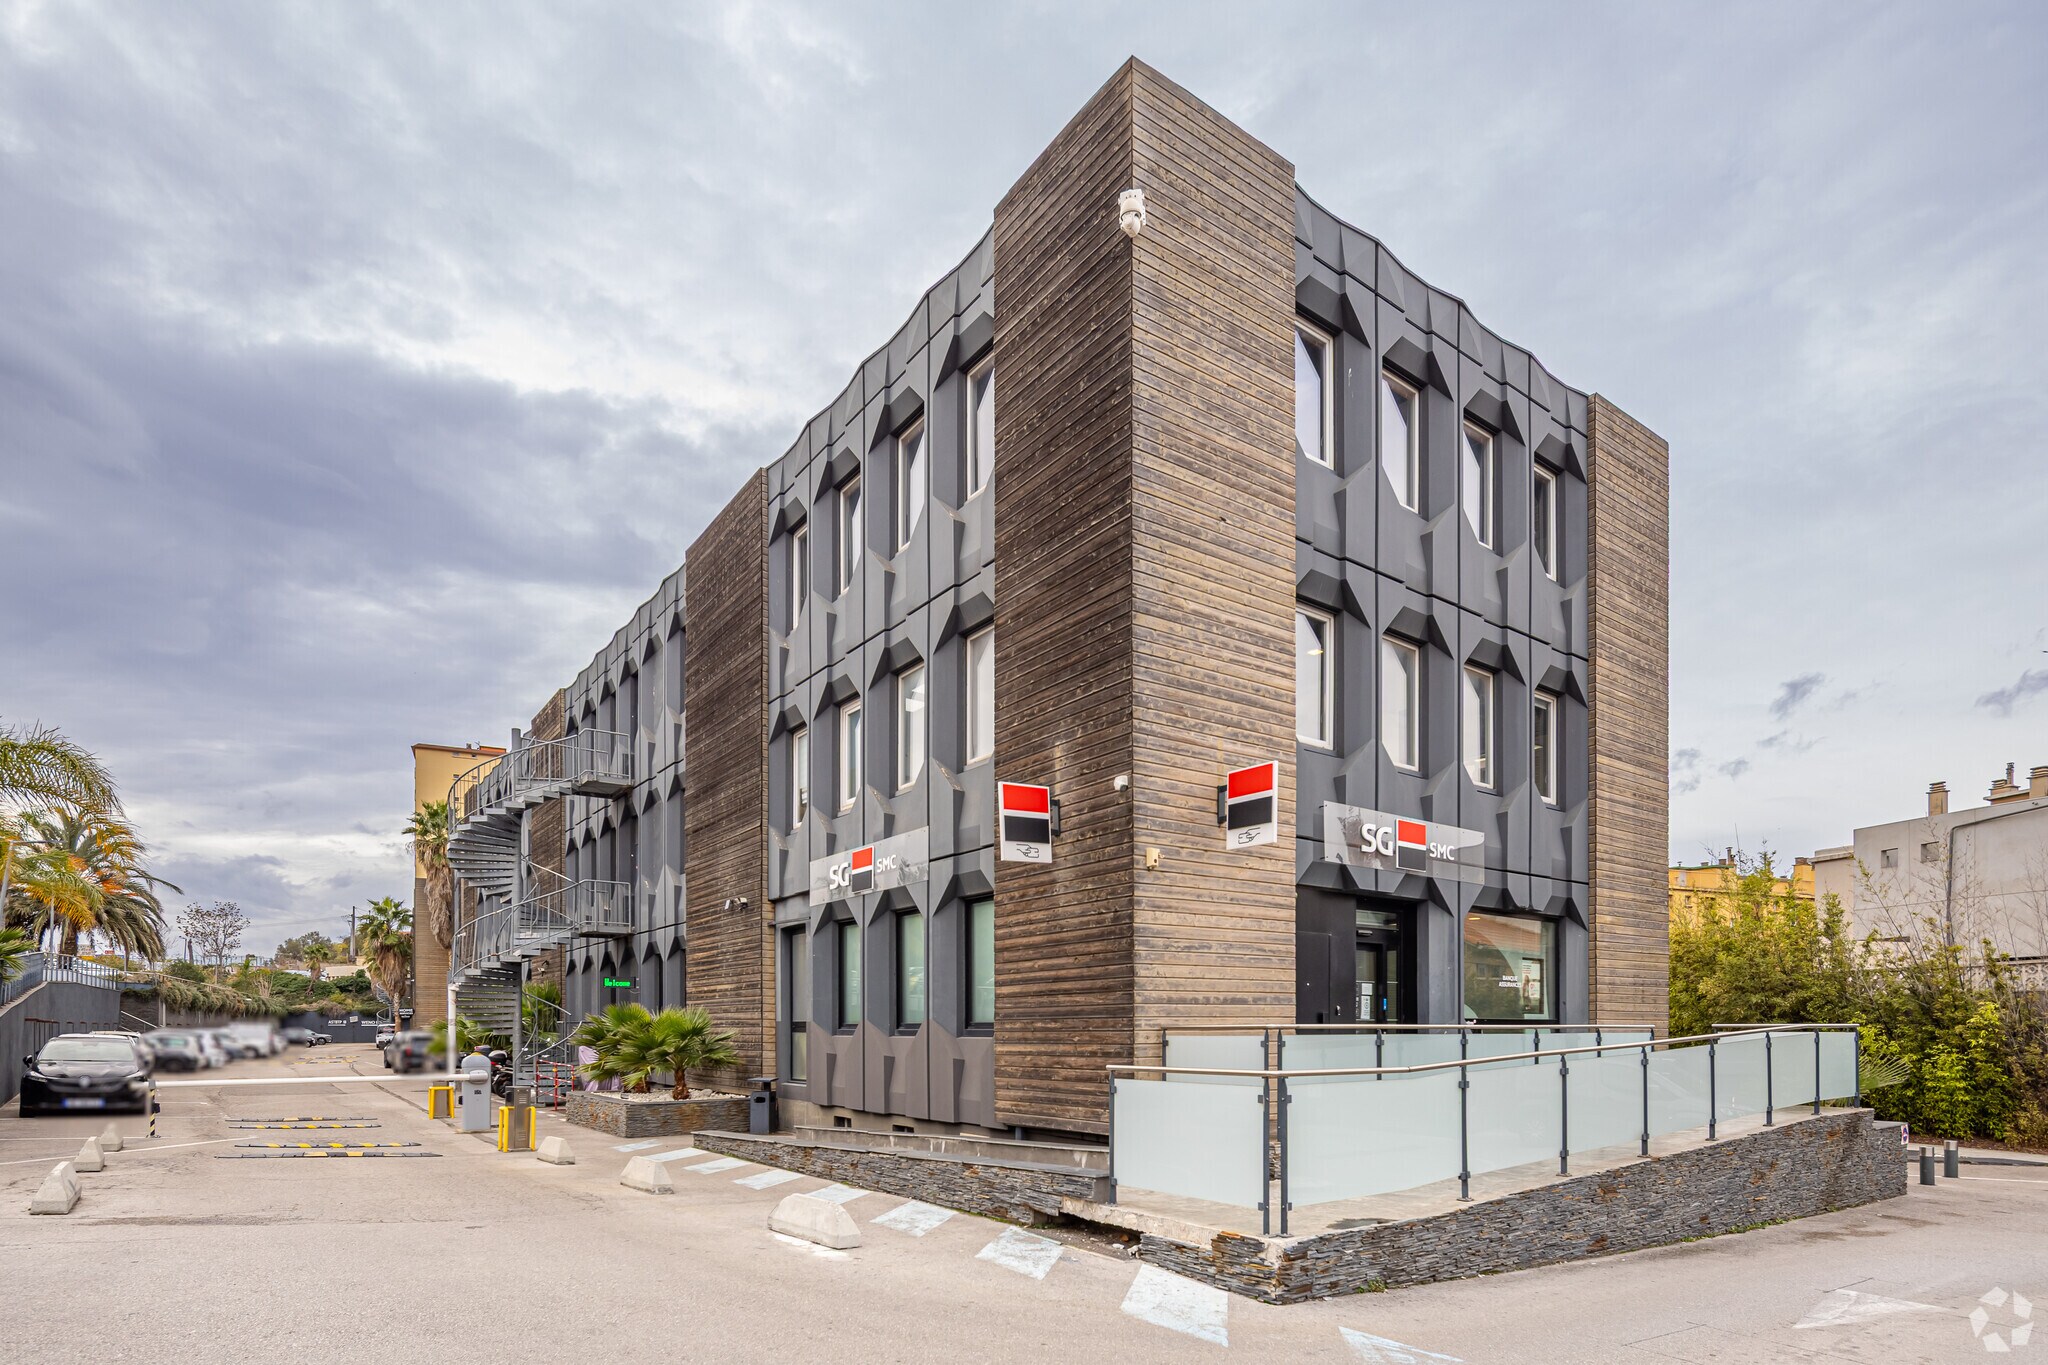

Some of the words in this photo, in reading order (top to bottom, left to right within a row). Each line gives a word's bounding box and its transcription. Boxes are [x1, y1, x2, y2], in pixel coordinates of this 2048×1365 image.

[1361, 823, 1394, 856] SG
[1429, 842, 1455, 861] SMC
[829, 861, 850, 890] SG
[876, 854, 897, 873] SMC
